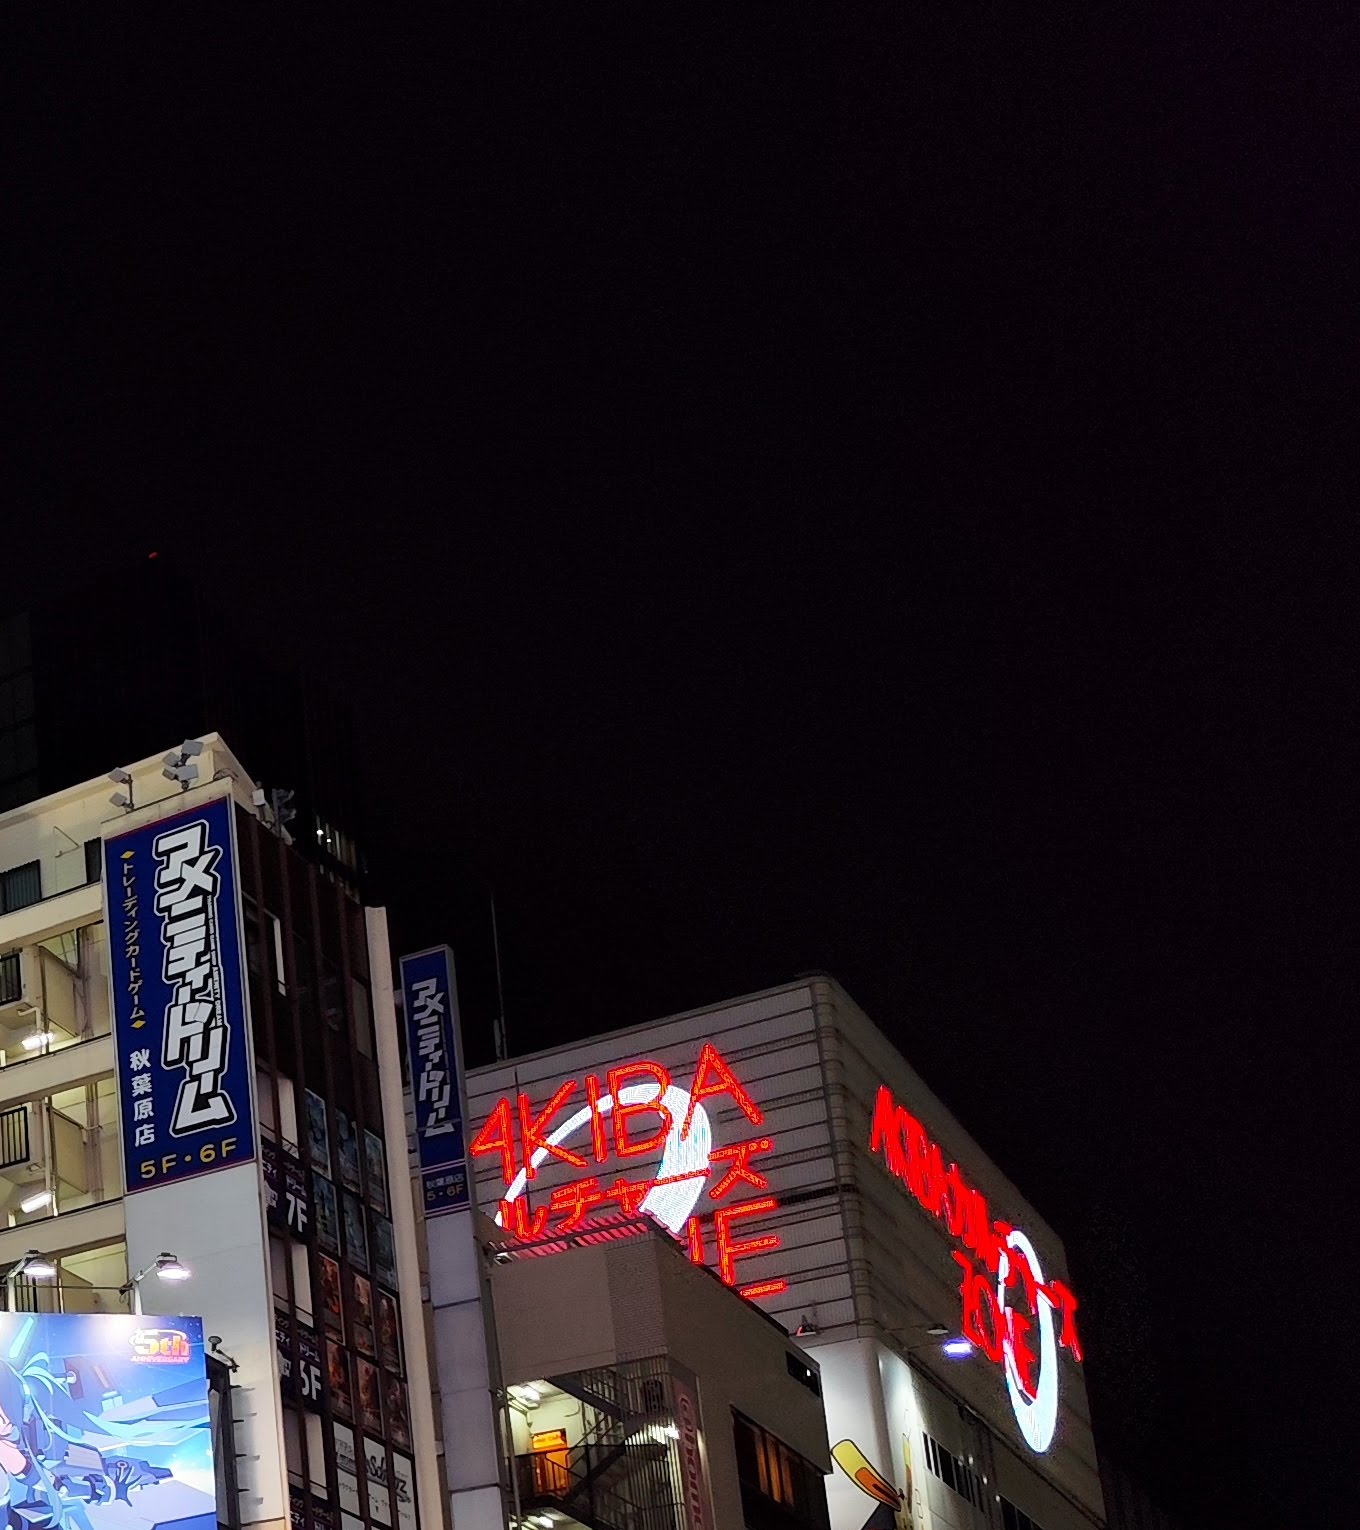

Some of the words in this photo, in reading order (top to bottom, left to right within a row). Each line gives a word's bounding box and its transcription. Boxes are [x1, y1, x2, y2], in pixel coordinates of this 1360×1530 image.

[121, 862, 147, 1019] トレーディングカードゲーム
[152, 820, 237, 1137] アメニティドリーム
[130, 1049, 156, 1146] 秋葉原店
[411, 978, 454, 1138] アメニティドリーム
[470, 1043, 764, 1184] AKIBA
[285, 1195, 307, 1233] 7F
